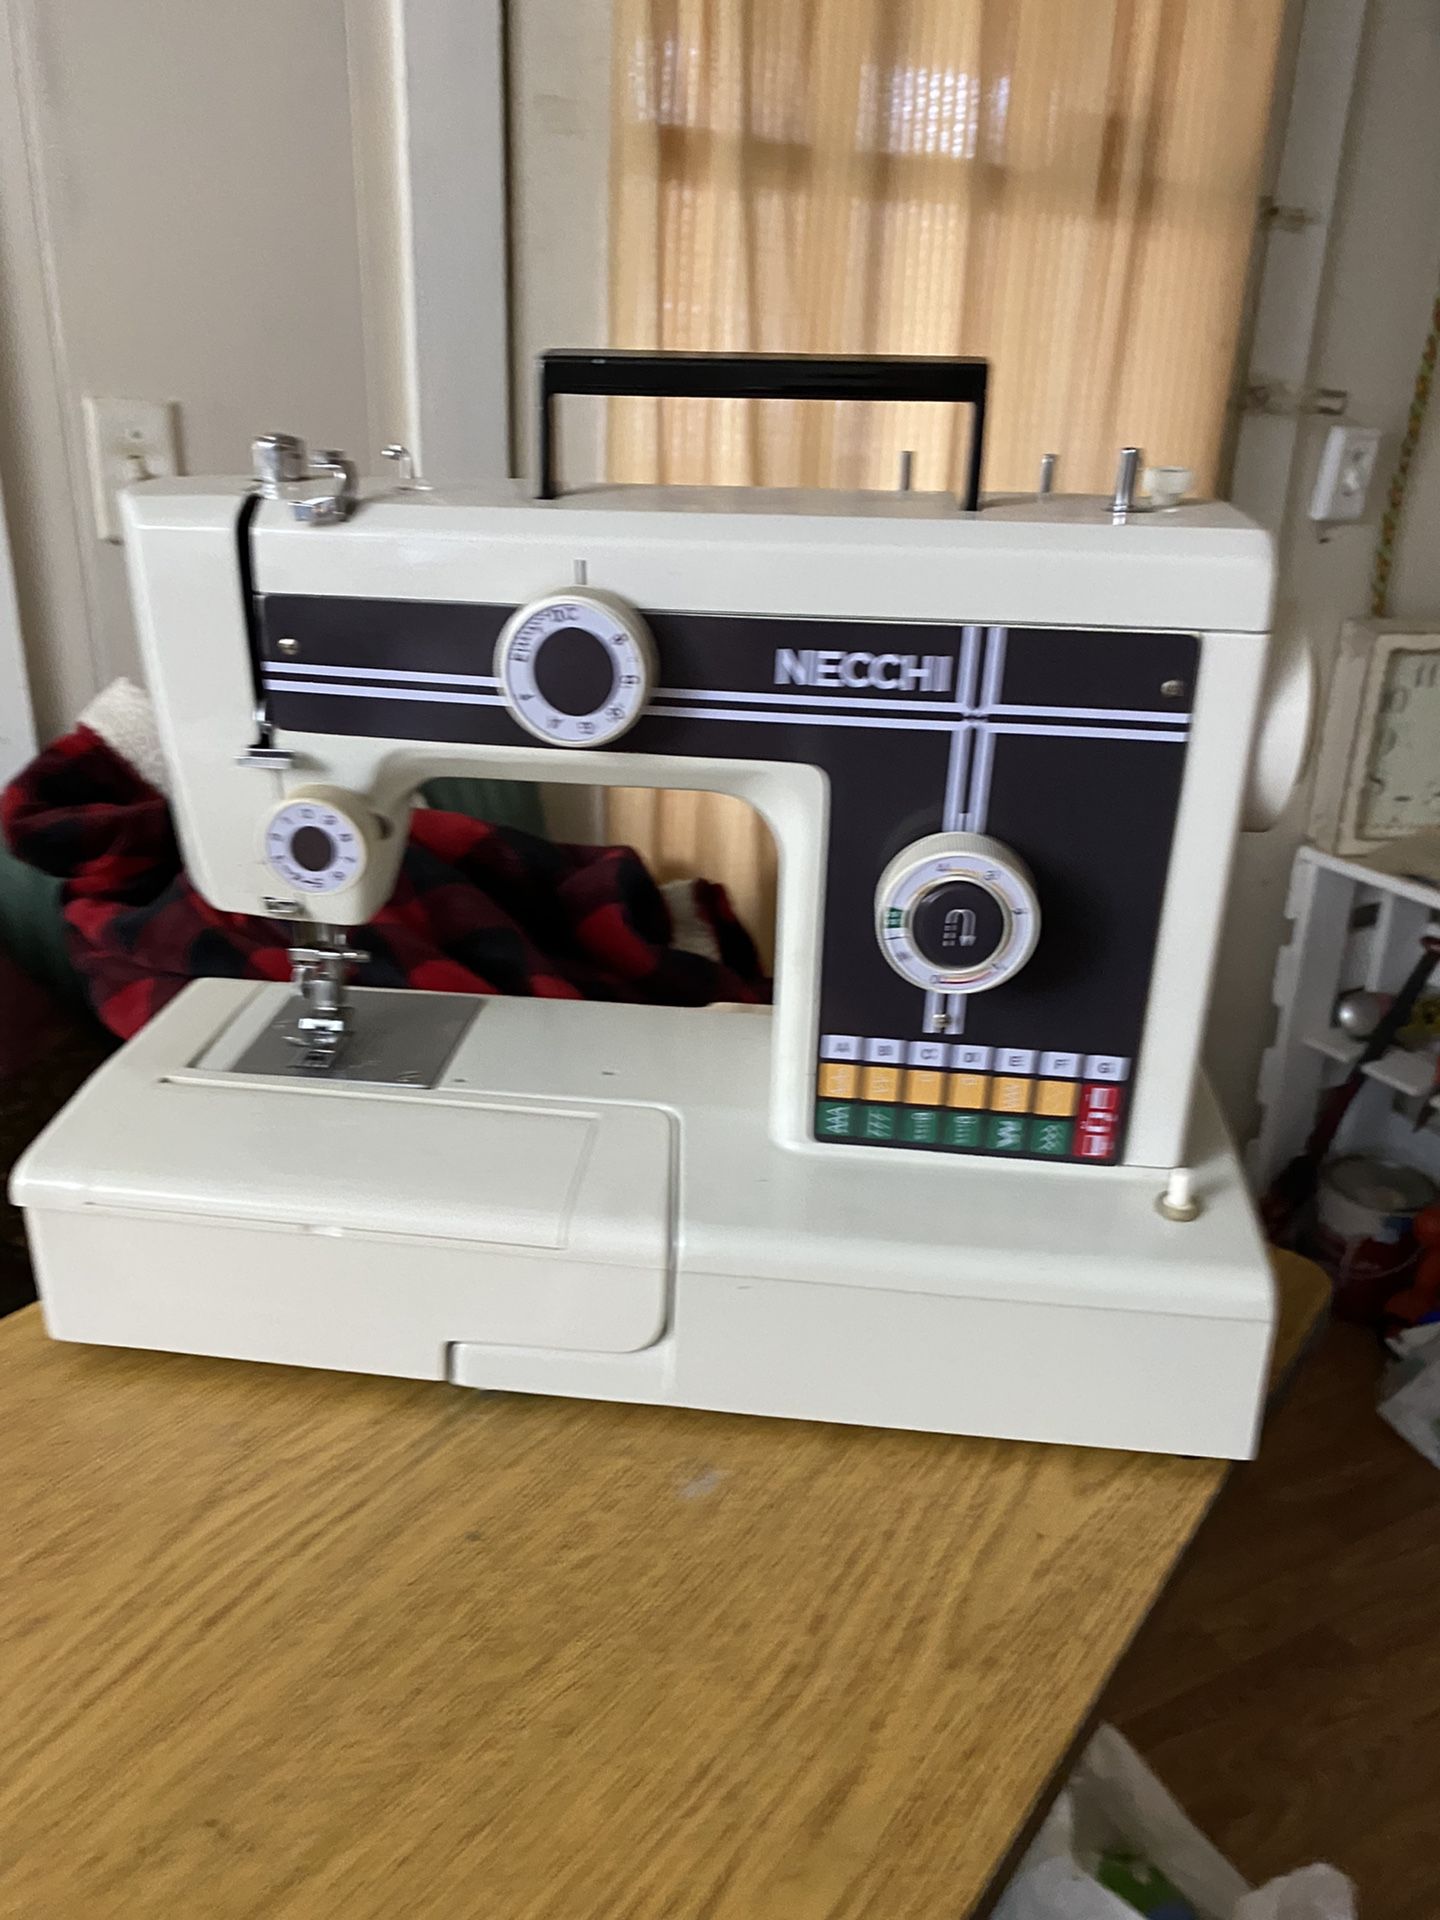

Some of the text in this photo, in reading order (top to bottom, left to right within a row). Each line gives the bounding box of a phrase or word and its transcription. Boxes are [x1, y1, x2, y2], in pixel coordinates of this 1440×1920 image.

[774, 648, 953, 692] NECCHI
[1008, 1055, 1025, 1067] E
[1054, 1058, 1071, 1070] F
[1097, 1062, 1114, 1074] G
